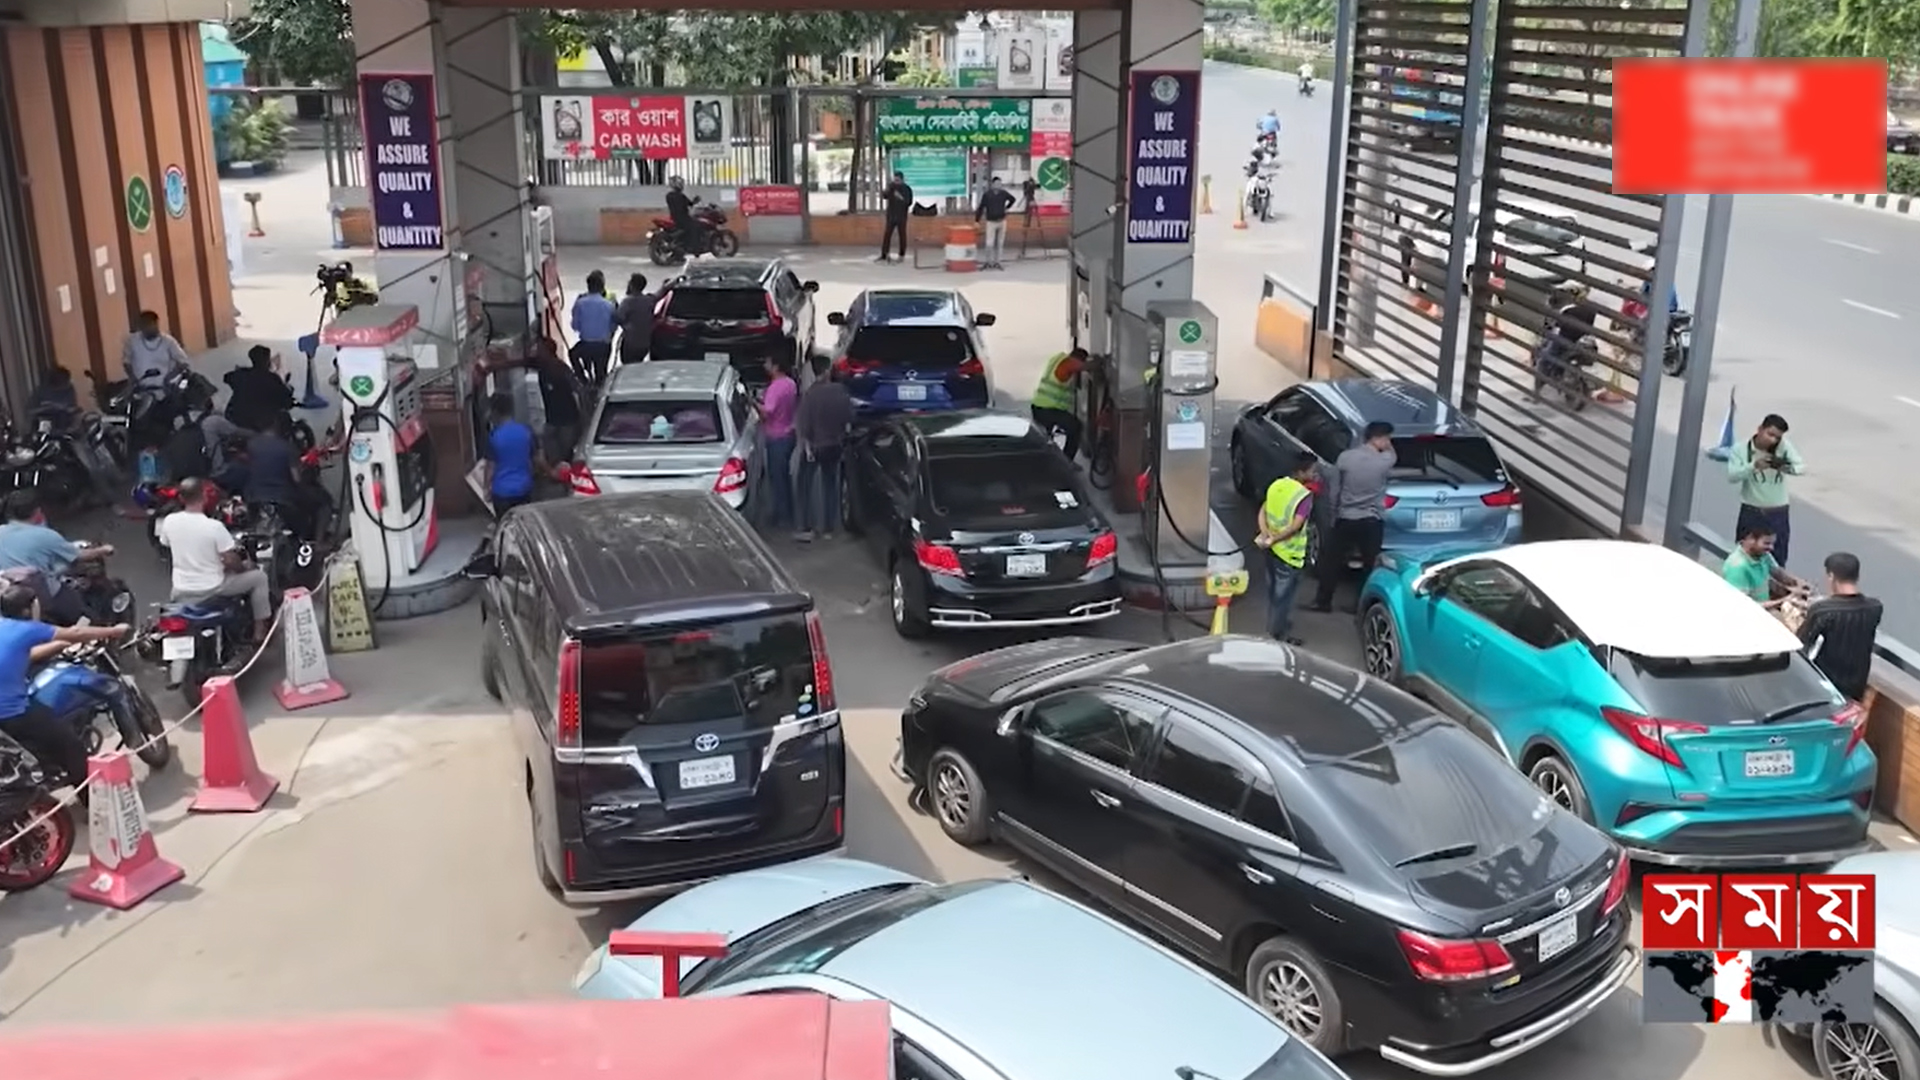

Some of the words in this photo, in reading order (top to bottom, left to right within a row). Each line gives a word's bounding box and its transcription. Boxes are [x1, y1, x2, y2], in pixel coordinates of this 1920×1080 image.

[389, 116, 412, 137] WE
[599, 109, 631, 127] কার
[636, 108, 680, 127] ওয়াশ
[1154, 111, 1174, 132] WE
[599, 133, 632, 148] CAR
[636, 133, 682, 148] WASH
[1138, 139, 1188, 159] ASSURE
[377, 144, 429, 165] ASSURE
[378, 171, 432, 194] QUALITY
[1136, 166, 1188, 188] QUALITY
[402, 201, 414, 219] &
[1154, 195, 1165, 212] &
[378, 225, 441, 248] QUANTITY
[1129, 219, 1190, 241] QUANTITY
